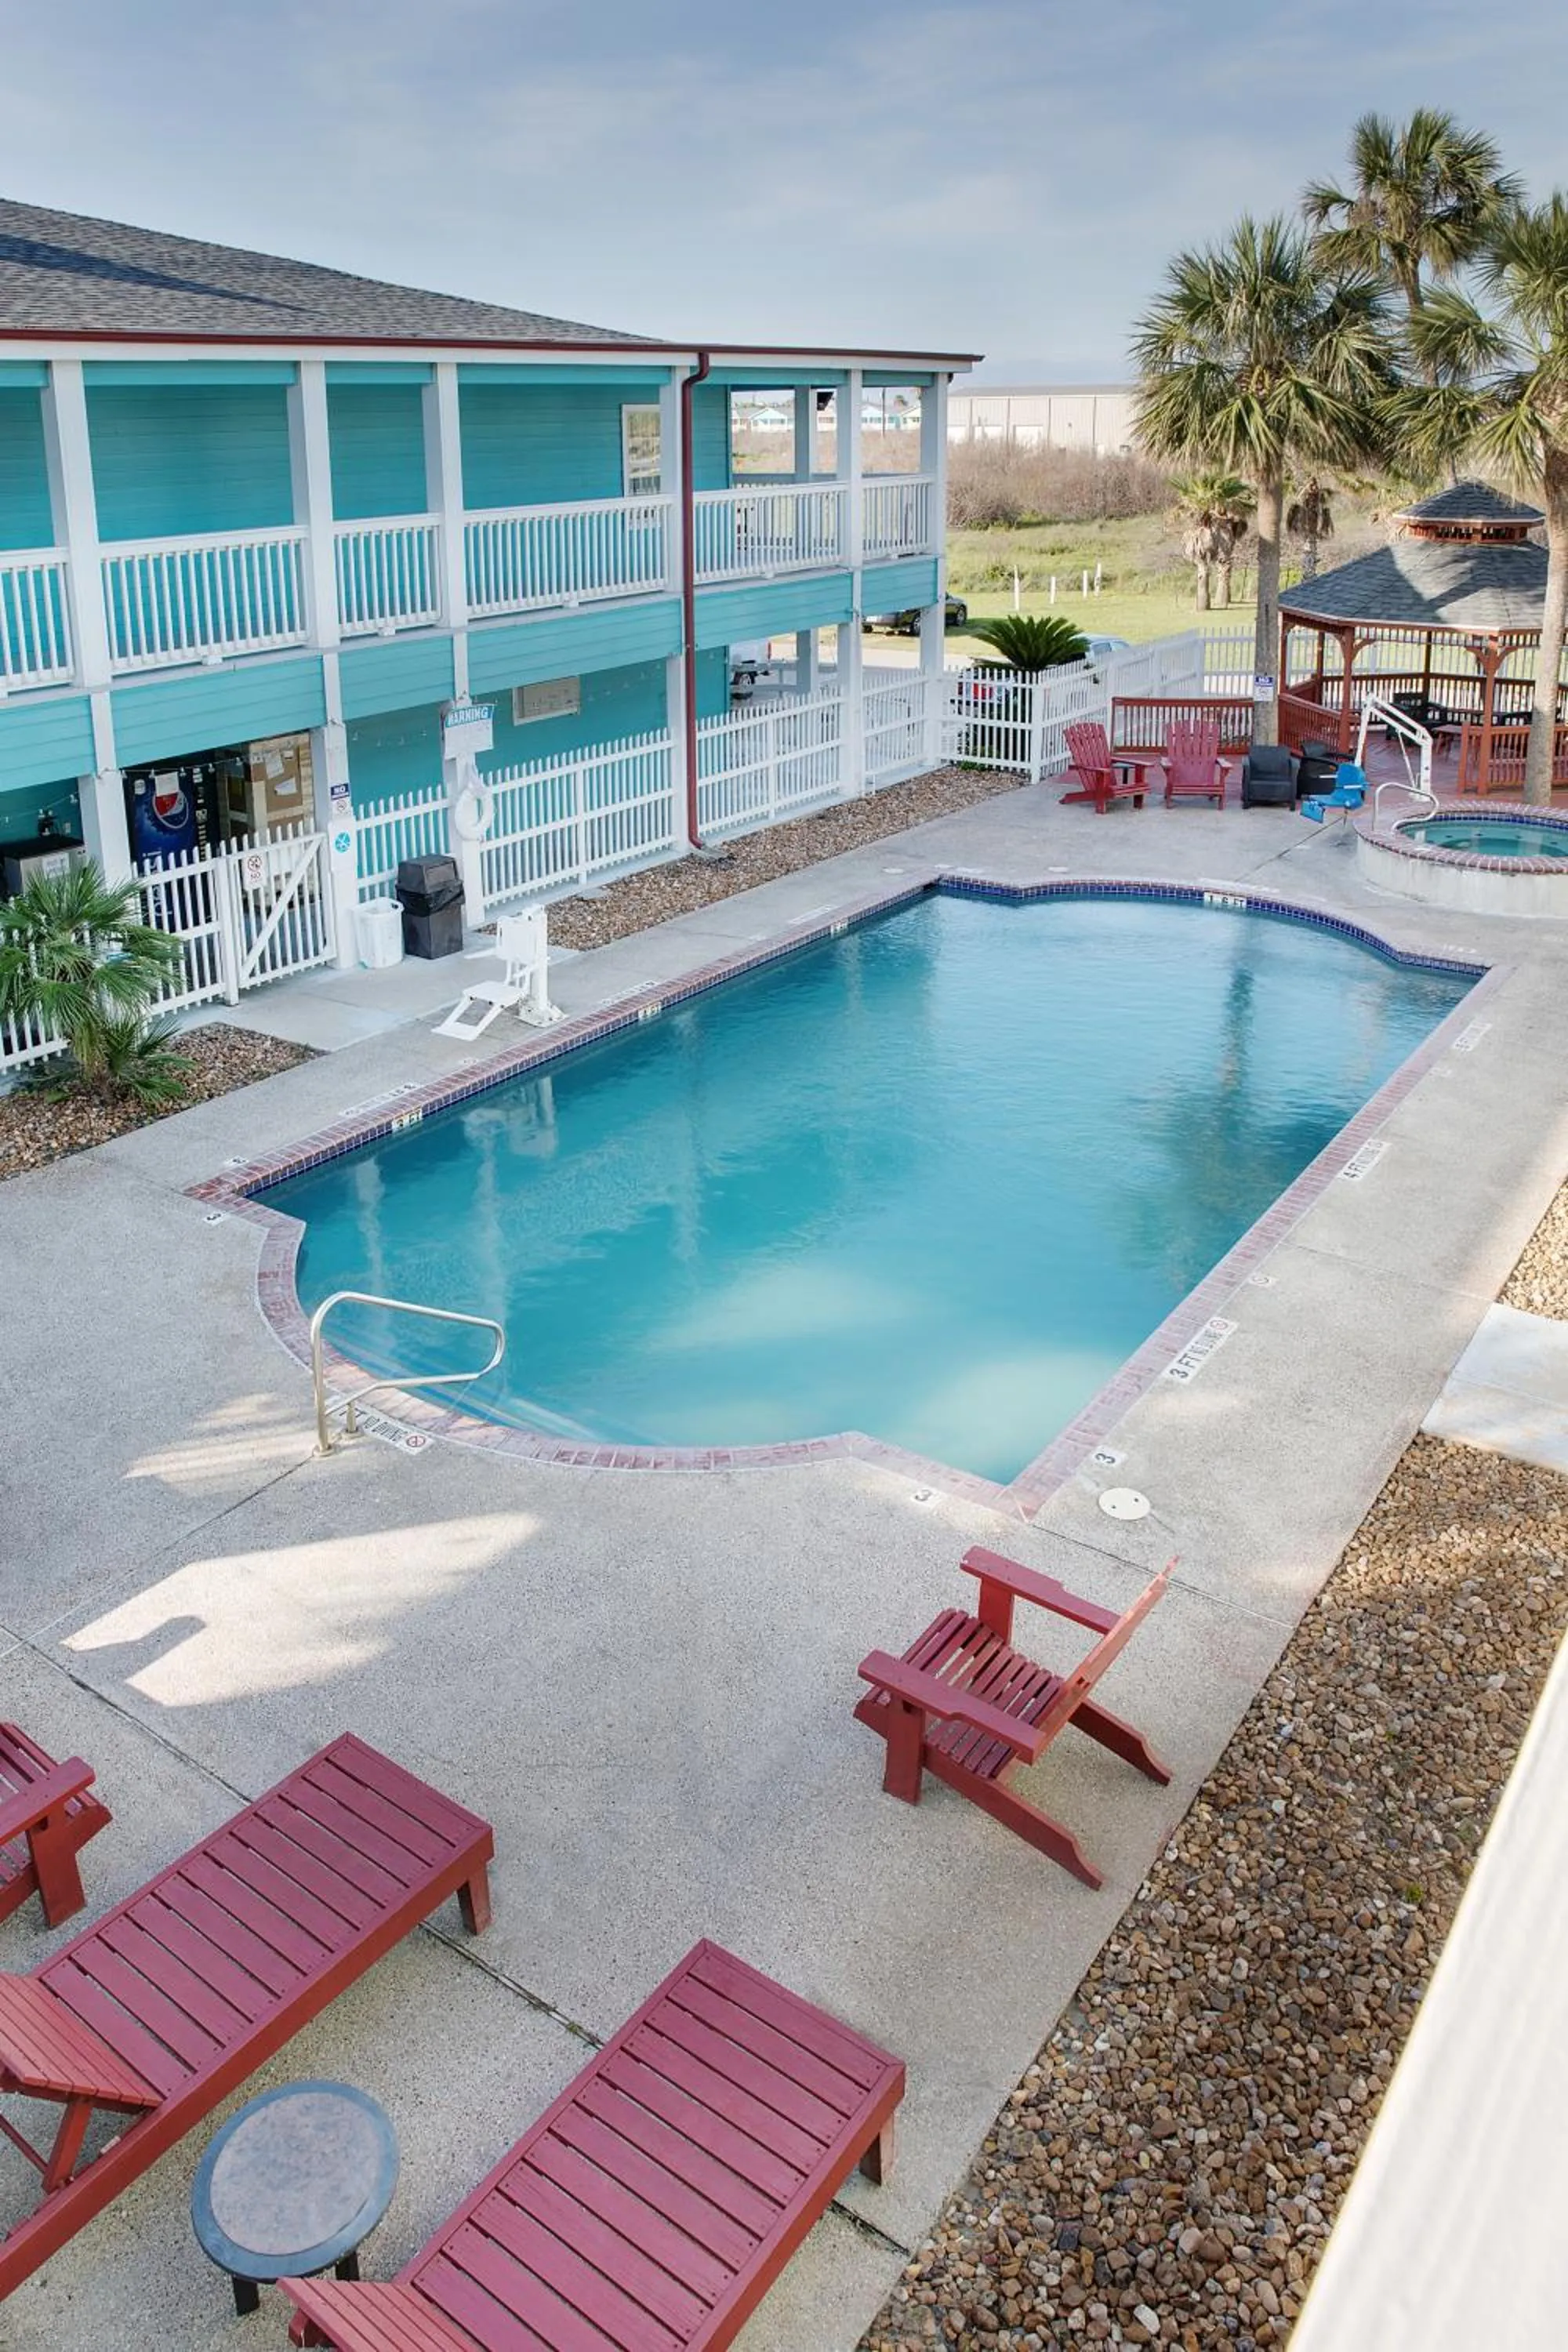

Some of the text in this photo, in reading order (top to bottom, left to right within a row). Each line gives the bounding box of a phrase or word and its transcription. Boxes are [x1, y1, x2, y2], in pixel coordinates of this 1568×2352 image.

[1169, 1353, 1203, 1380] 3 FT
[1095, 1452, 1116, 1465] 3
